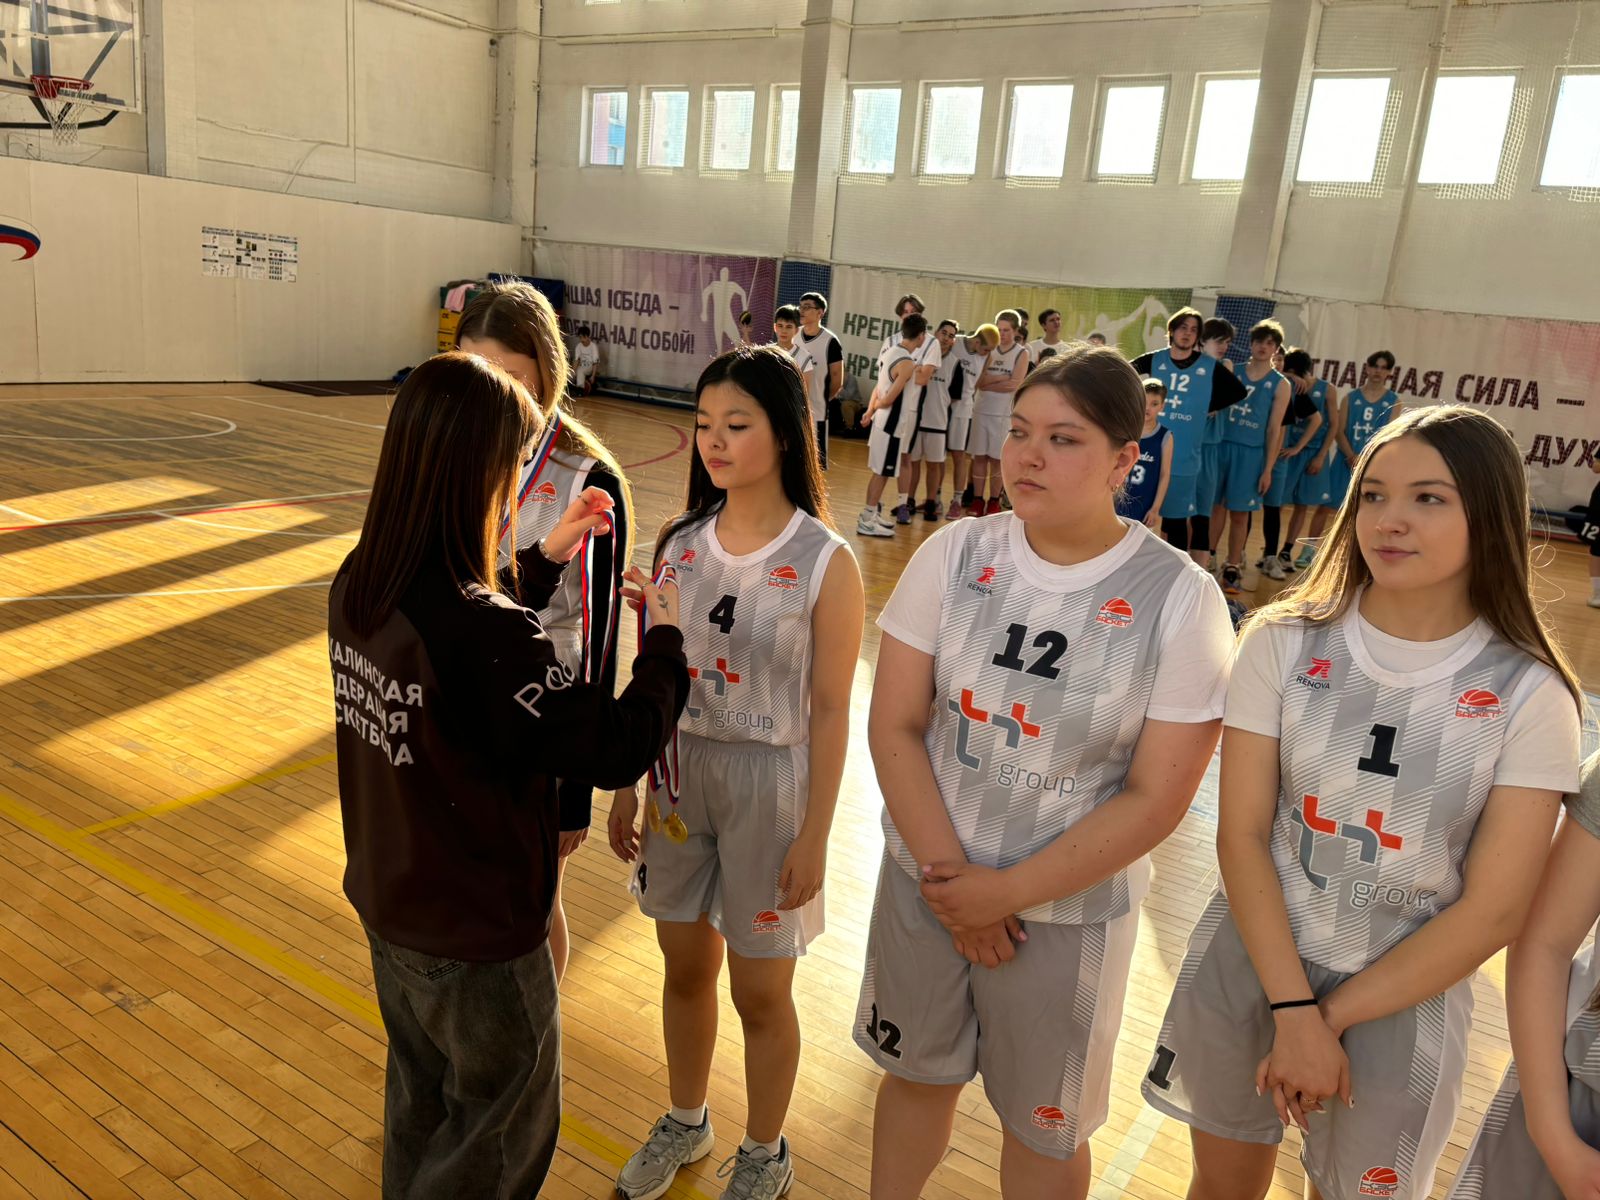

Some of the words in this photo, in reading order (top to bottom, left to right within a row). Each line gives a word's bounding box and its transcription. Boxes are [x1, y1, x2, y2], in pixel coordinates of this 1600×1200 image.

[641, 329, 695, 354] СОБОЙ!
[1169, 373, 1190, 392] 12
[1455, 374, 1539, 410] СИЛА
[1169, 412, 1192, 421] group
[1363, 407, 1373, 420] 6
[1581, 522, 1600, 540] 12
[708, 594, 738, 635] 4
[991, 622, 1069, 681] 12
[1296, 675, 1330, 690] RENOVA
[713, 709, 774, 731] group
[1357, 722, 1400, 778] 1
[997, 763, 1076, 798] group
[866, 1002, 902, 1060] 12
[1148, 1044, 1177, 1091] 1
